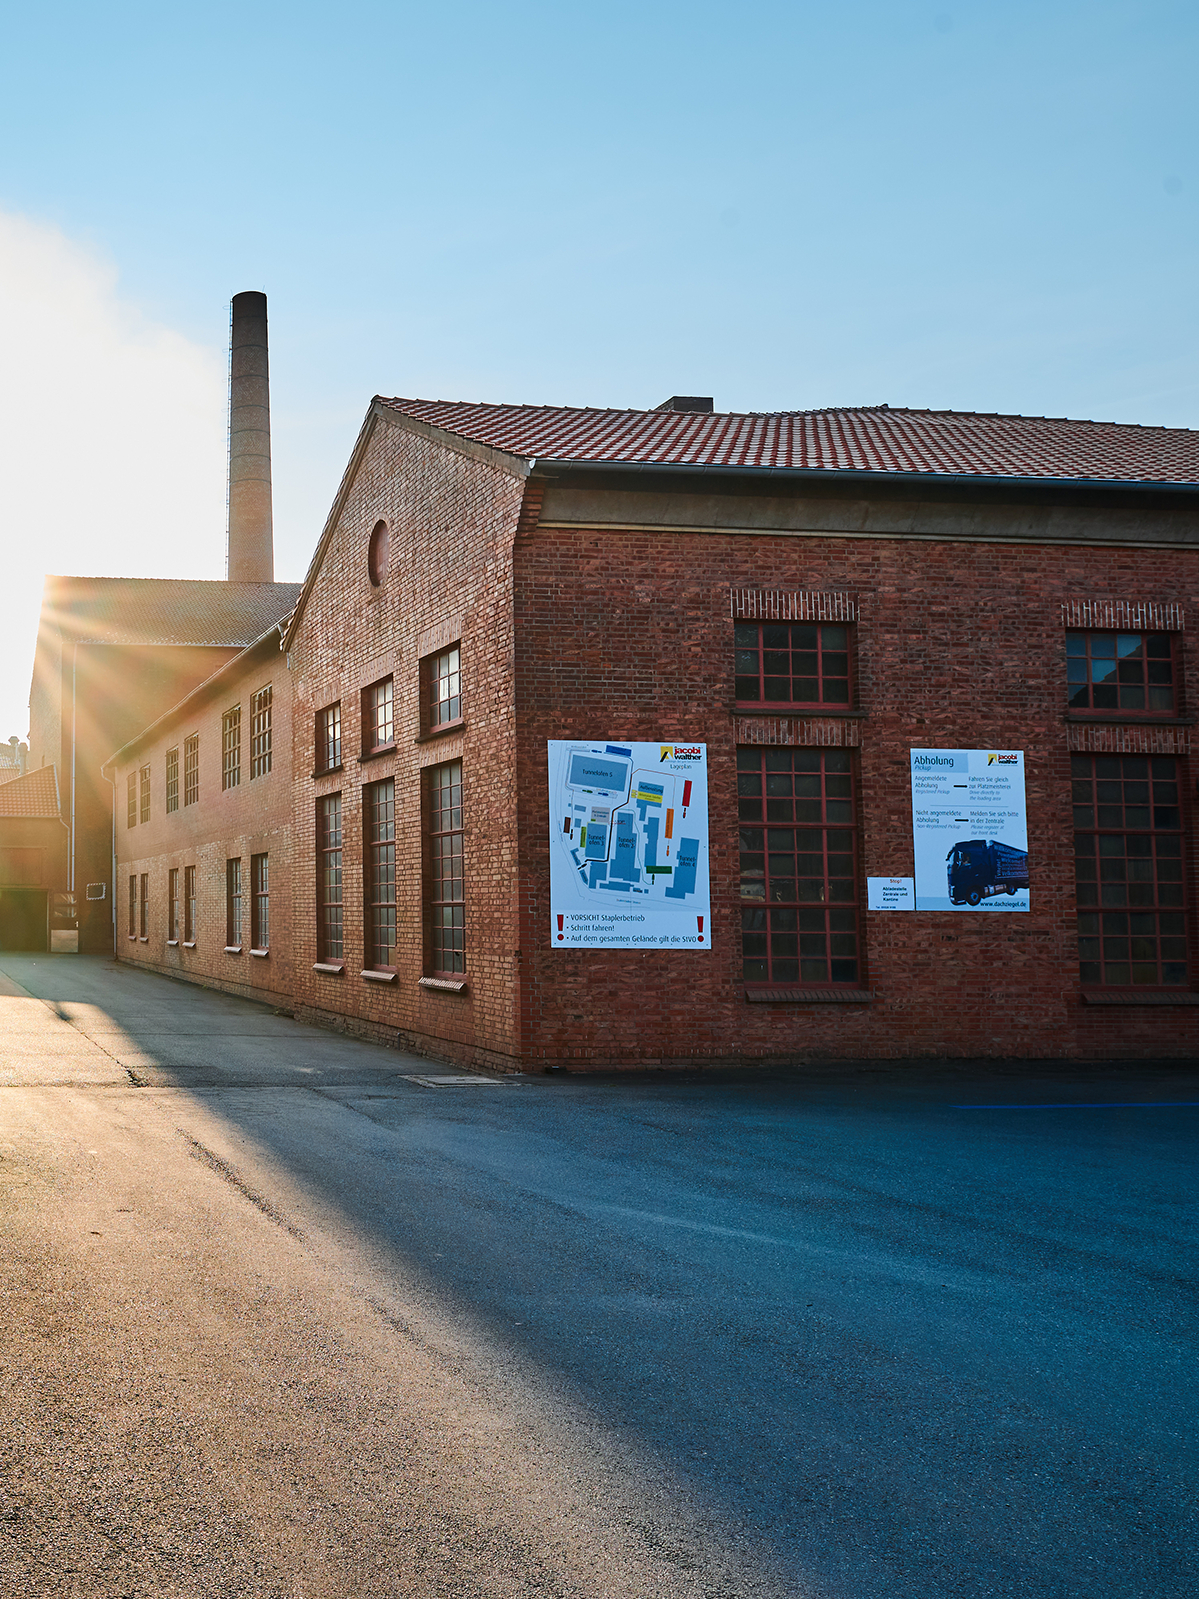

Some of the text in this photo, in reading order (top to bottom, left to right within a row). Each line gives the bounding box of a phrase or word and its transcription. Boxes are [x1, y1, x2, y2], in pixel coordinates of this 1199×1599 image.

[674, 746, 701, 755] jacobi
[914, 755, 954, 768] Abholung
[582, 769, 608, 777] Tunnelofen
[601, 914, 645, 922] Staplerbetrieb
[599, 935, 630, 943] gesamten
[659, 935, 669, 944] gilt
